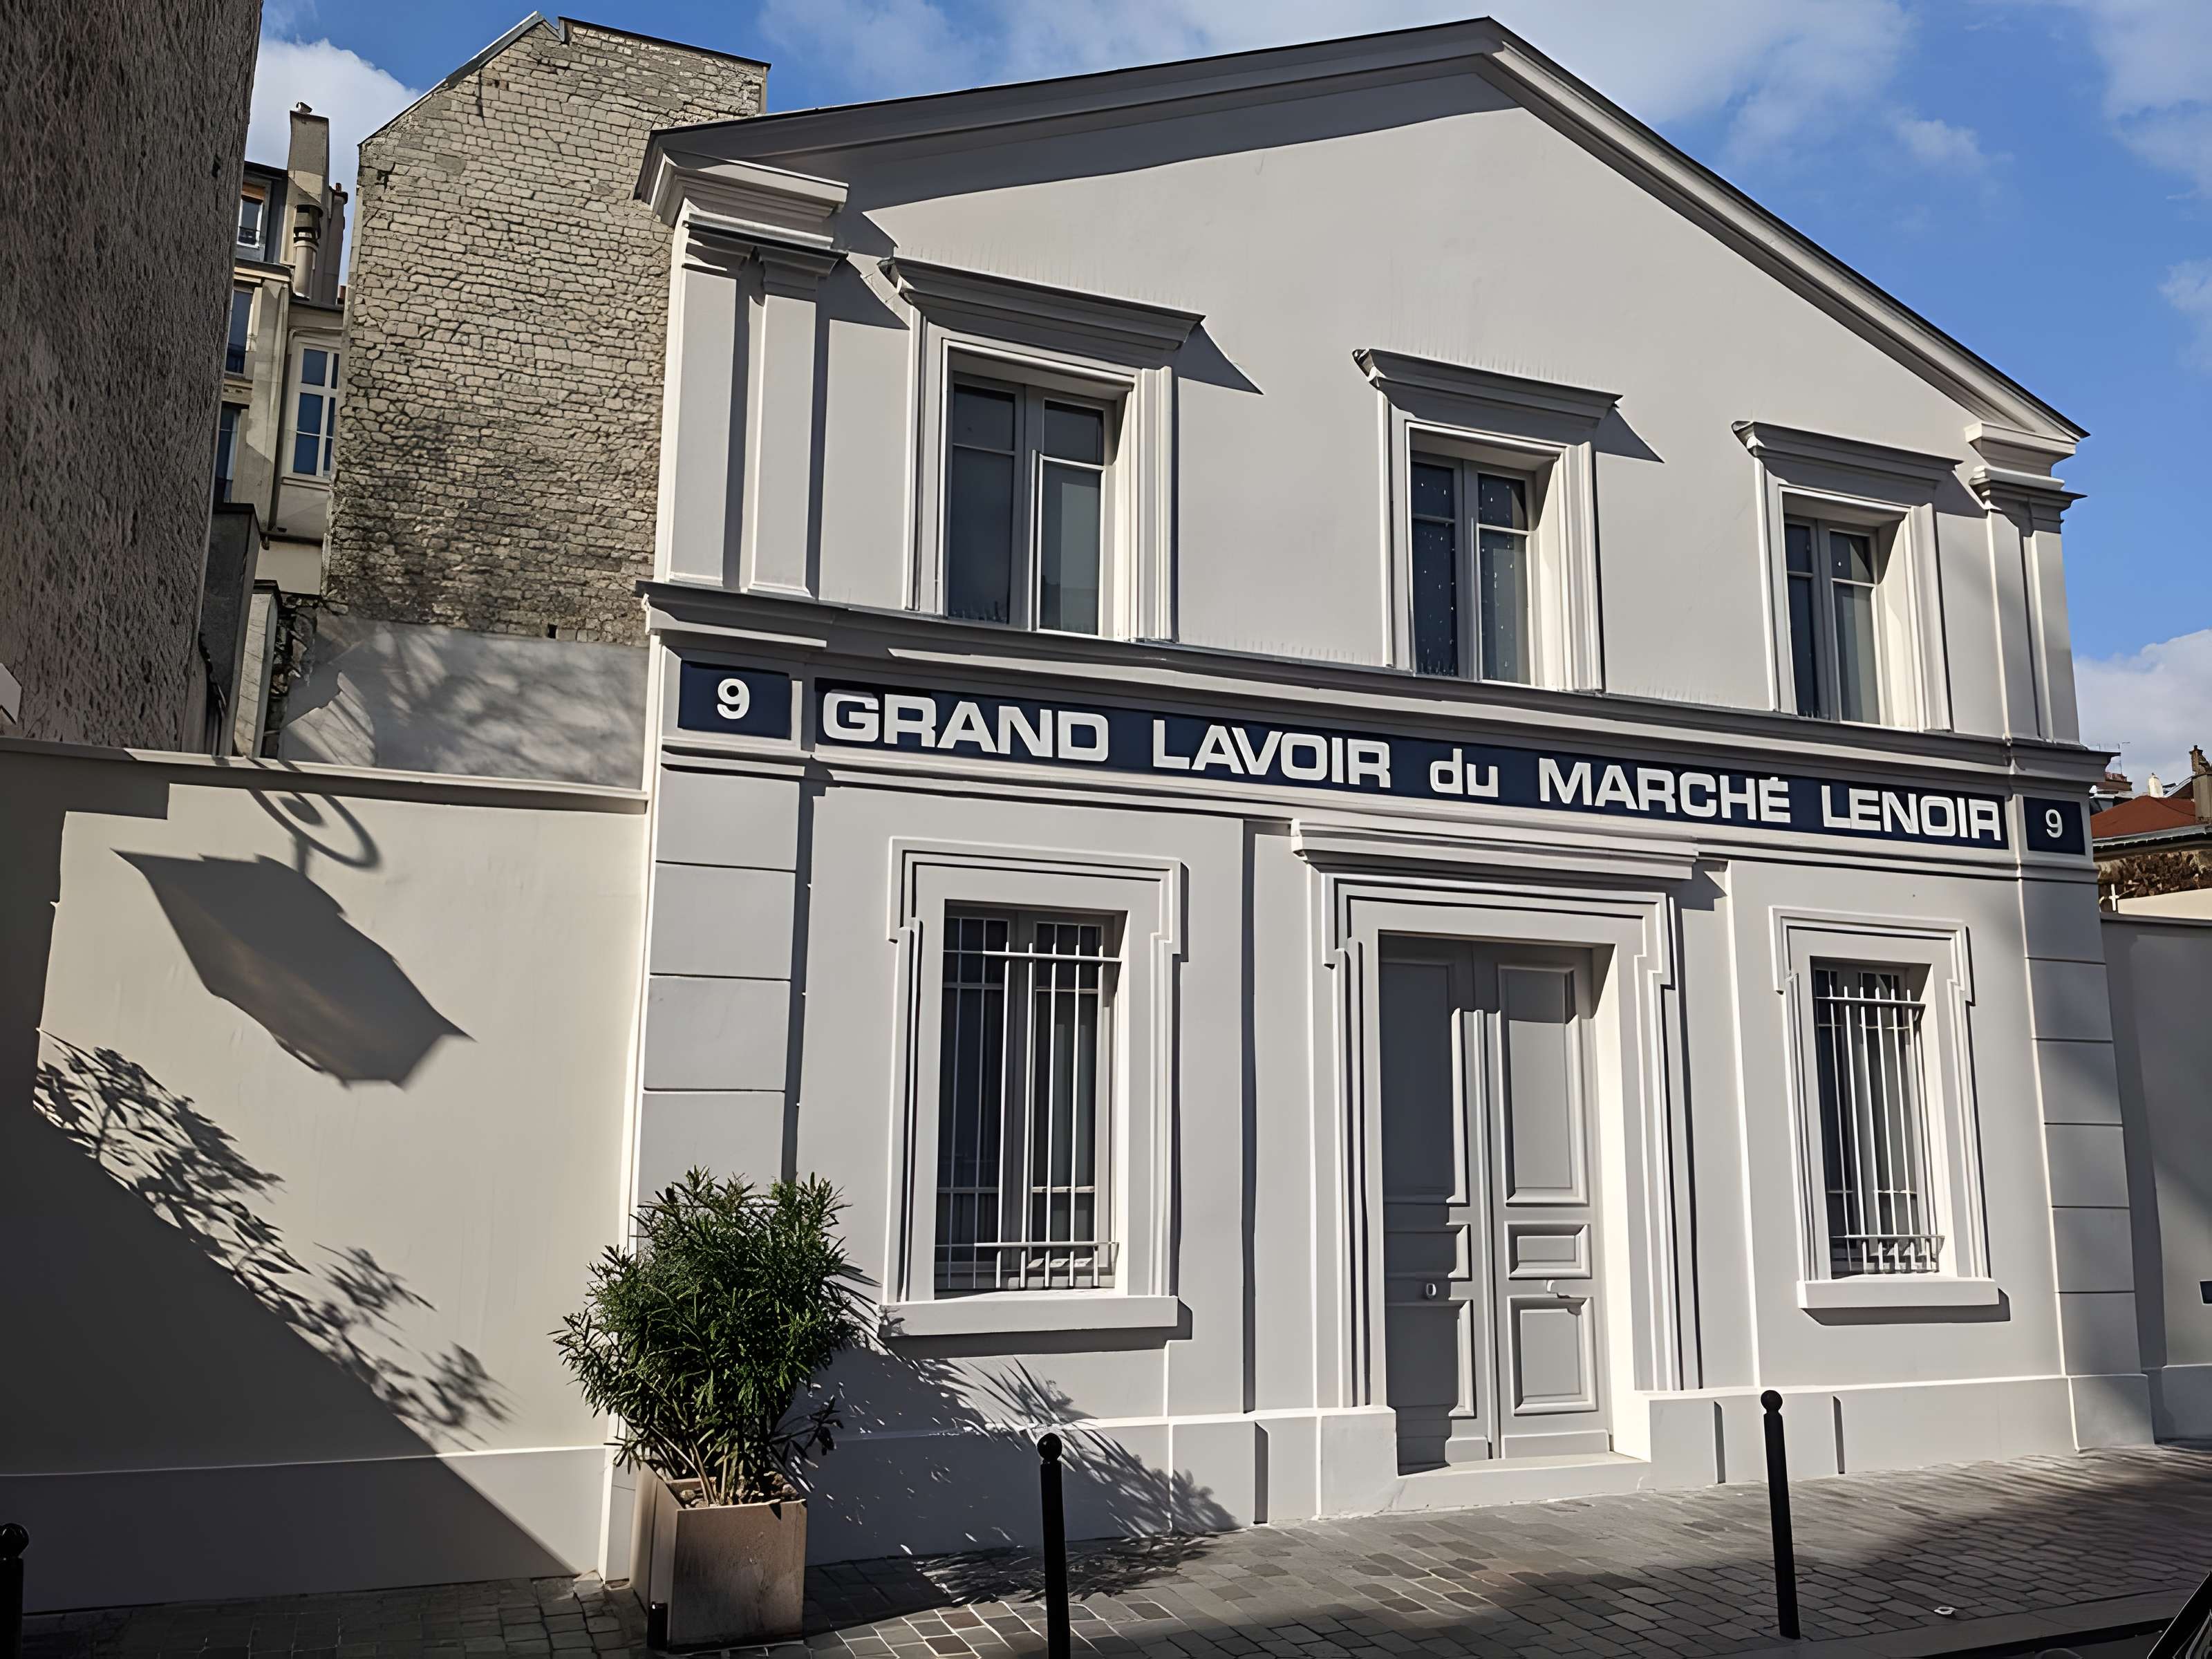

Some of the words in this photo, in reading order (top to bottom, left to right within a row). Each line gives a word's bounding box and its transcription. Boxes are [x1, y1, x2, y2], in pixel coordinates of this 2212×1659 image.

[717, 678, 750, 720] 9
[823, 691, 1109, 762] GRAND
[1152, 719, 1392, 788] LAVOIR
[1430, 748, 1499, 798] du
[1539, 757, 1791, 823] MARCHÉ
[1821, 785, 2002, 841] LENOIR
[2045, 808, 2063, 838] 9
